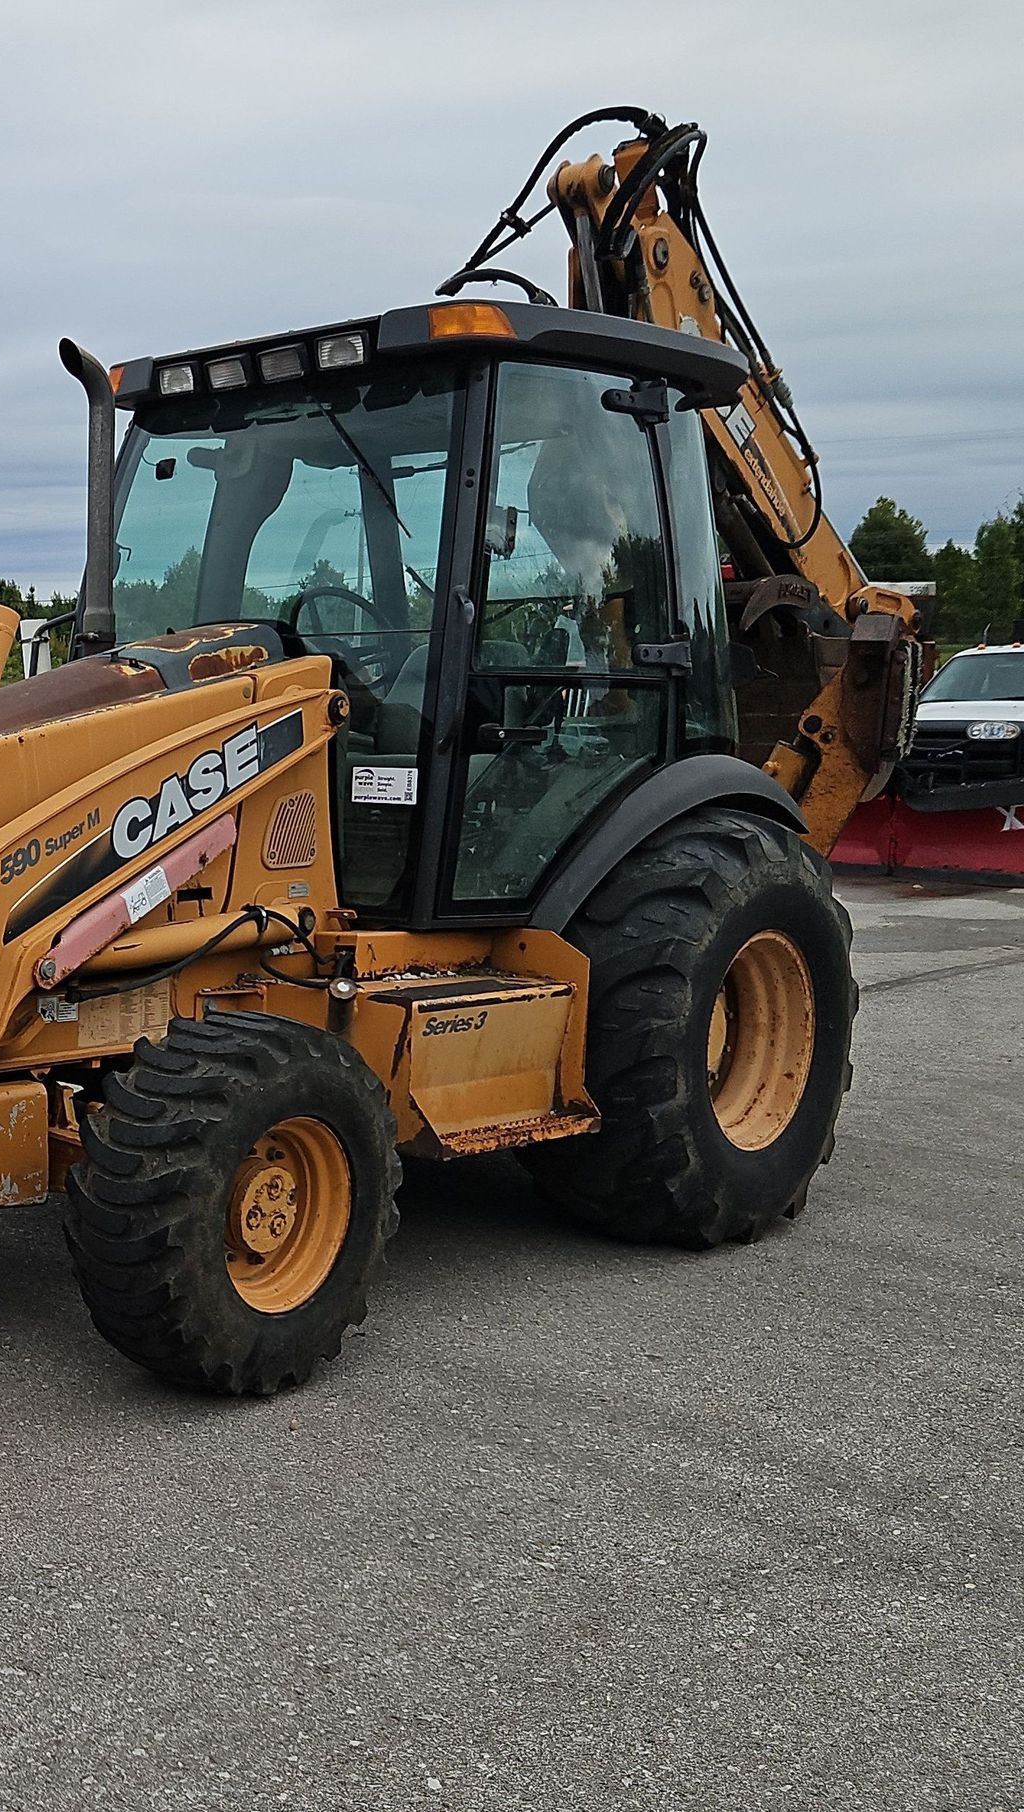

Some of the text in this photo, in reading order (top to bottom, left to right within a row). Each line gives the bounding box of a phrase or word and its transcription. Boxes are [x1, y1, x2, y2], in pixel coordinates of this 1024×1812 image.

[112, 723, 260, 859] CASE
[0, 807, 101, 885] 590 Super M
[422, 1010, 489, 1037] Series 3
